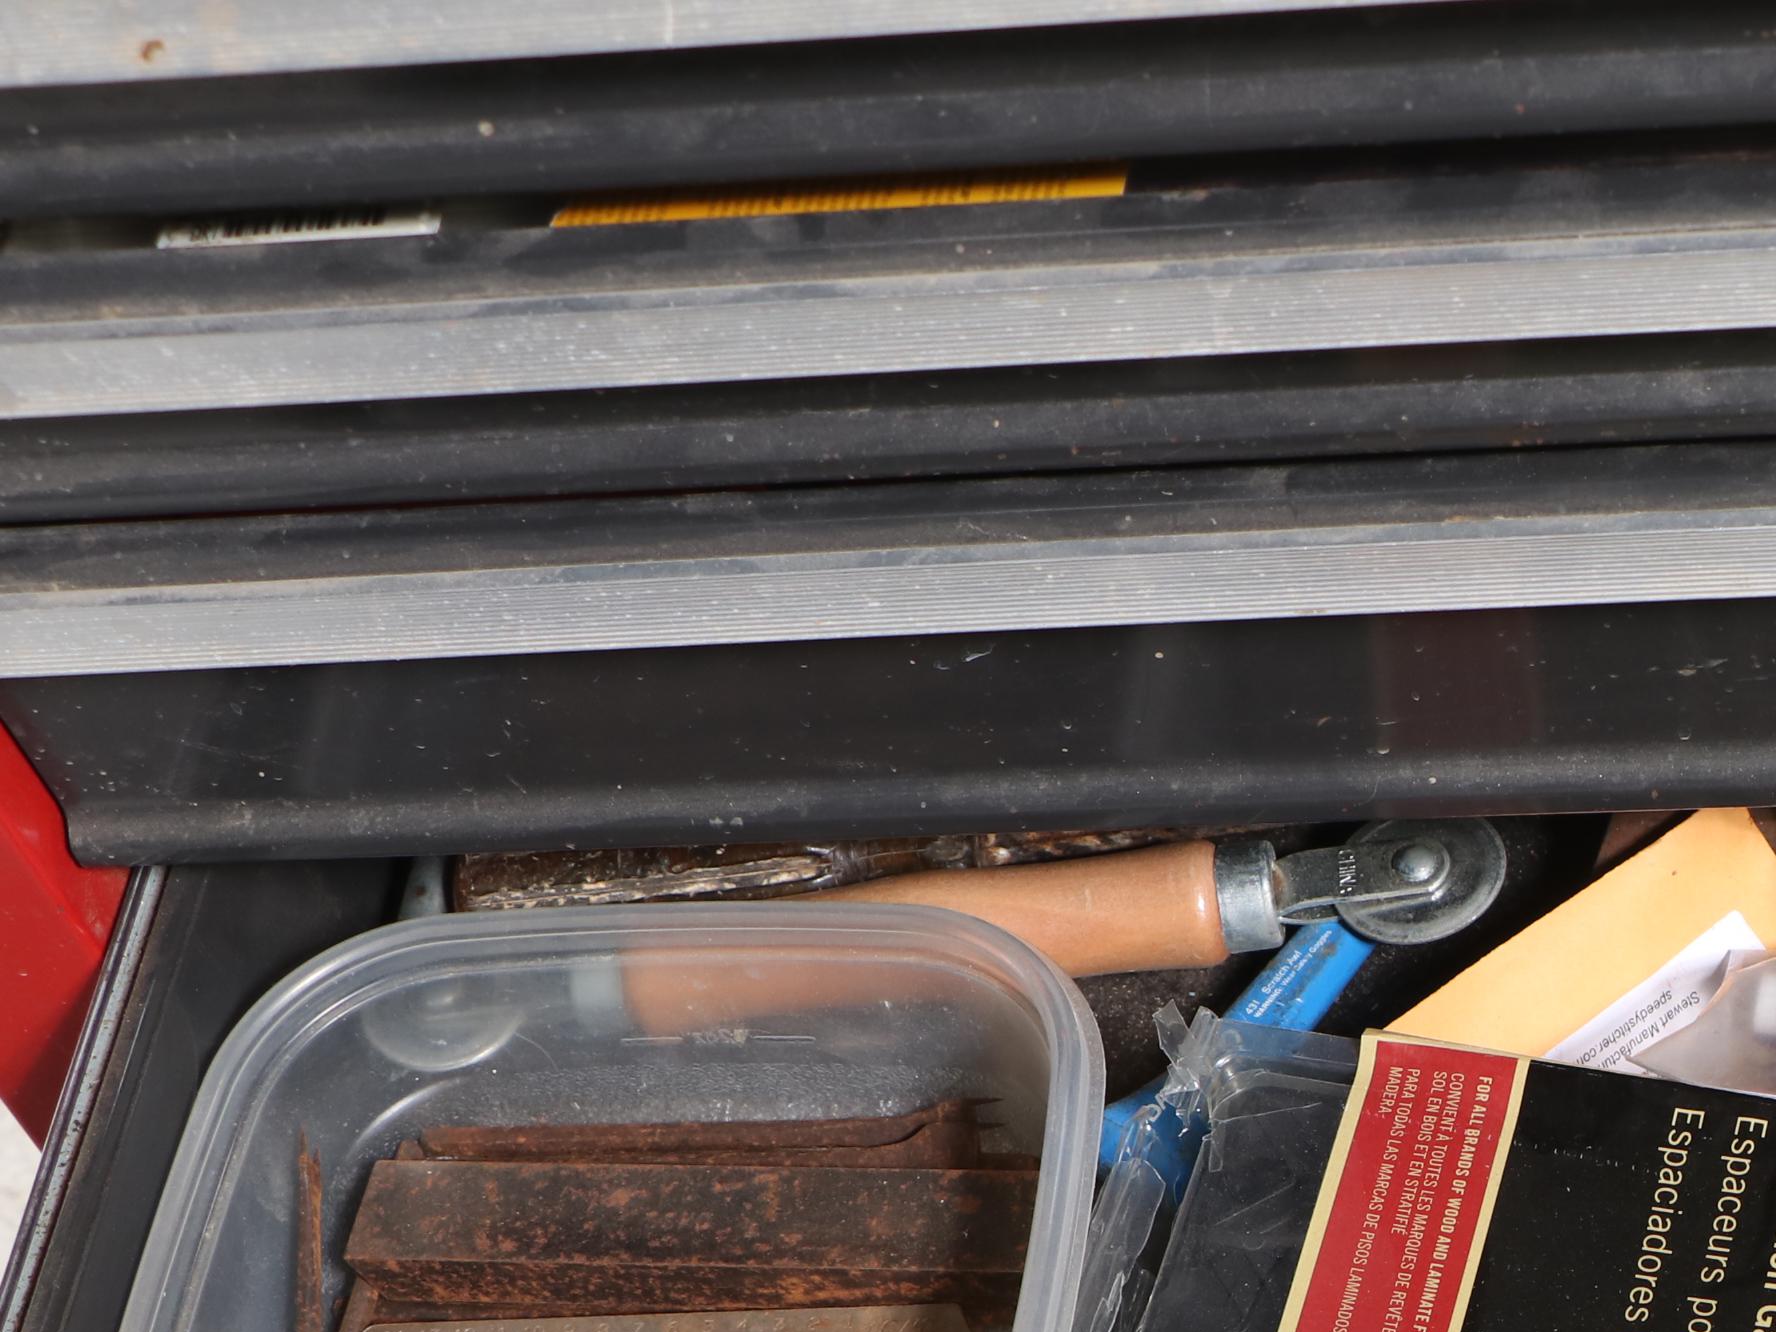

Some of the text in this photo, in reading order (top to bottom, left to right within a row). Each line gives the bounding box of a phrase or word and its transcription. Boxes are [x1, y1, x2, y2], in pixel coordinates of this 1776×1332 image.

[1246, 999, 1259, 1015] 431
[1262, 966, 1289, 995] Scratch
[1659, 990, 1700, 1026] Stewart
[1401, 1068, 1420, 1098] PARA
[1475, 1076, 1492, 1101] FOR
[1390, 1102, 1412, 1136] TODAS
[1439, 1072, 1464, 1131] CONVIENT
[1469, 1104, 1486, 1125] ALL
[1383, 1139, 1401, 1160] LAS
[1391, 1071, 1447, 1235] SOL EN BOIS ET EN STRATIFIÉ
[1423, 1144, 1447, 1187] TOUTES
[1455, 1128, 1480, 1176] BRANDS
[1368, 1163, 1394, 1210] MARCAS
[1416, 1189, 1434, 1211] LES
[1451, 1179, 1466, 1195] OF
[1700, 1116, 1768, 1282] Espaceurs
[1363, 1213, 1380, 1229] DE
[1440, 1198, 1462, 1233] WOOD
[1624, 1107, 1704, 1321] Espaciadores
[1353, 1231, 1375, 1264] PISOS
[1400, 1213, 1428, 1269] MARQUES
[1432, 1235, 1451, 1260] AND
[1394, 1272, 1411, 1288] DE
[1415, 1262, 1444, 1322] LAMINATE
